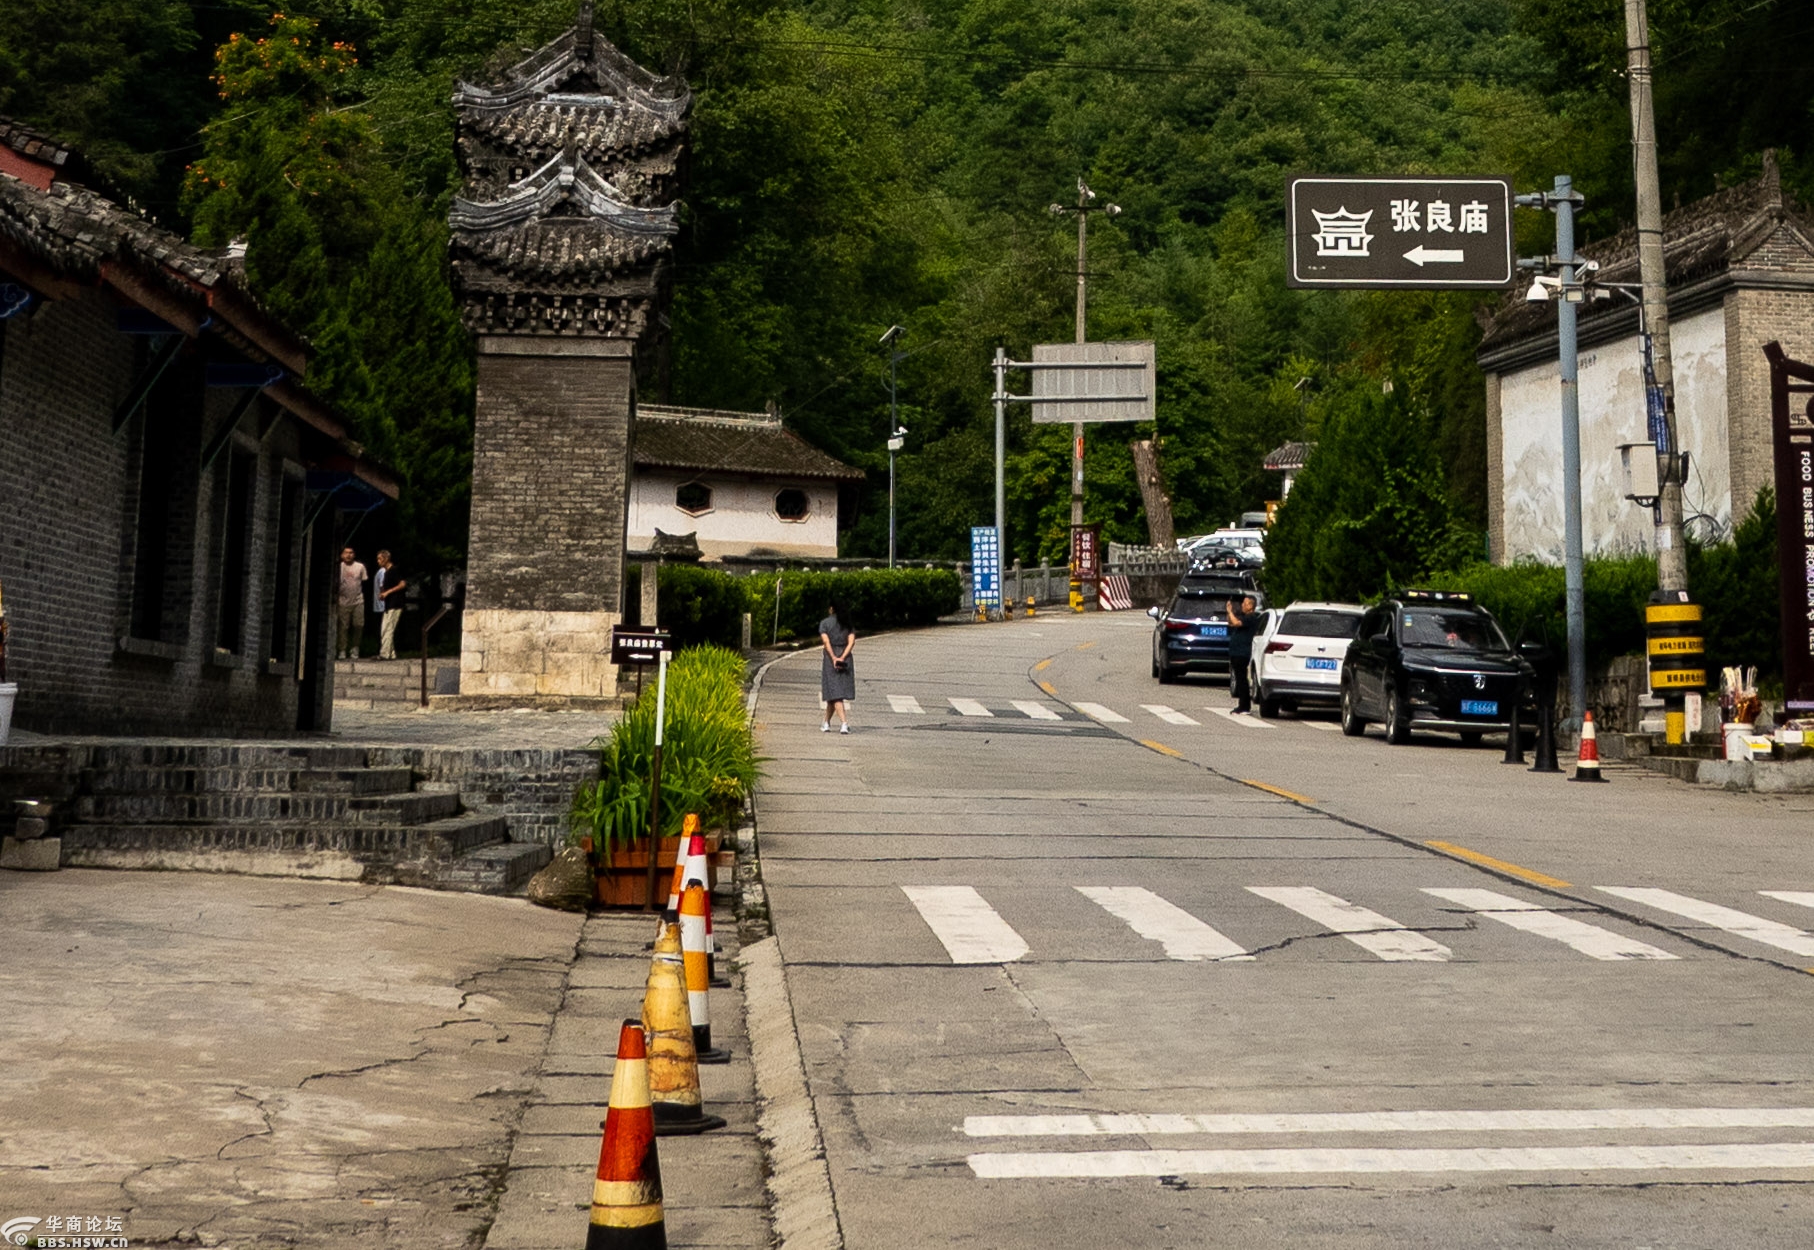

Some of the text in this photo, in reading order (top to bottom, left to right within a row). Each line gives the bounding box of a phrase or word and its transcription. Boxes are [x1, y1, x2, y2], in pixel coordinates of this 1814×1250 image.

[1390, 199, 1489, 233] 张良庙
[1801, 451, 1812, 481] FOOD
